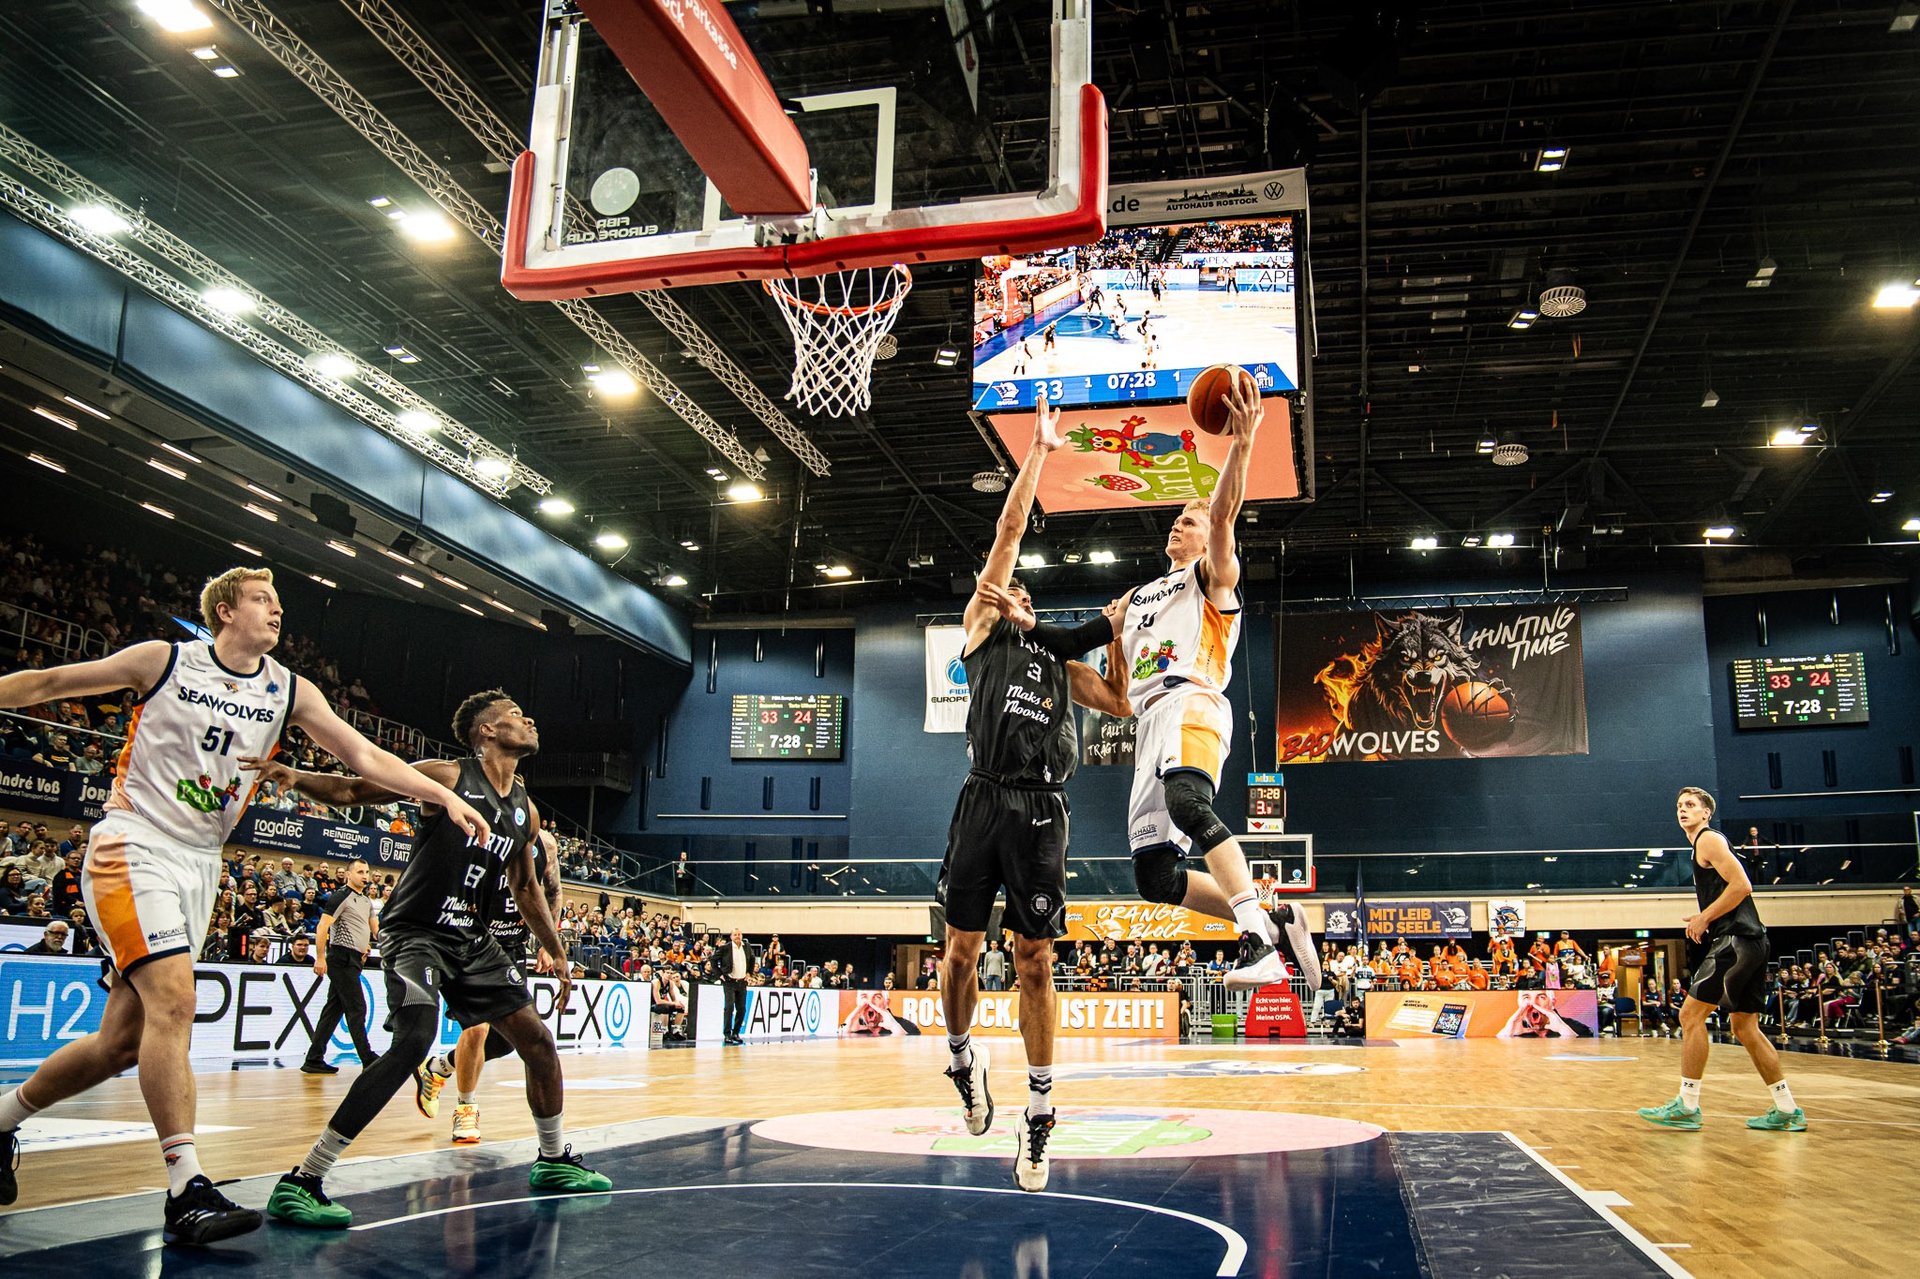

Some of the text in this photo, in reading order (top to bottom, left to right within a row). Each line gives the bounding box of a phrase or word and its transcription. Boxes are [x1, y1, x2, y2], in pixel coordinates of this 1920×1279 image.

[1166, 197, 1259, 211] AUTOHAUS ROSTOCK
[1034, 380, 1064, 400] 33
[1084, 377, 1093, 388] 1
[1107, 372, 1156, 389] 07:28
[1129, 390, 1136, 398] 2
[1139, 454, 1200, 500] Karls
[1468, 606, 1576, 651] HUNTING
[1508, 632, 1570, 670] TIME
[1026, 662, 1043, 683] 3
[1770, 672, 1832, 689] 33 24
[177, 686, 276, 724] SEAWOLVES
[931, 696, 968, 704] EUROPE
[1005, 684, 1054, 710] Maks &
[1783, 699, 1822, 715] 7:28
[761, 711, 778, 724] 33
[794, 711, 812, 724] 24
[1003, 699, 1051, 725] Moorits
[200, 725, 234, 757] 51
[769, 735, 801, 749] 7:28
[1280, 730, 1441, 762] BAD WOLVES
[37, 777, 60, 795] Voß
[1256, 788, 1281, 799] 7:28
[254, 816, 304, 838] rogatec
[322, 828, 370, 844] REINIGUNG
[393, 849, 410, 863] RATZ
[441, 895, 468, 912] Maks
[1096, 902, 1190, 924] ORANGE
[1369, 907, 1433, 922] MIT LEIB
[1126, 920, 1199, 941] BLOCK
[1396, 920, 1442, 934] SEELE
[6, 970, 323, 1051] H2 PEX
[534, 982, 604, 1041] PEX
[749, 990, 807, 1034] APEX
[902, 997, 1165, 1031] ROSCK, IST ZEIT!
